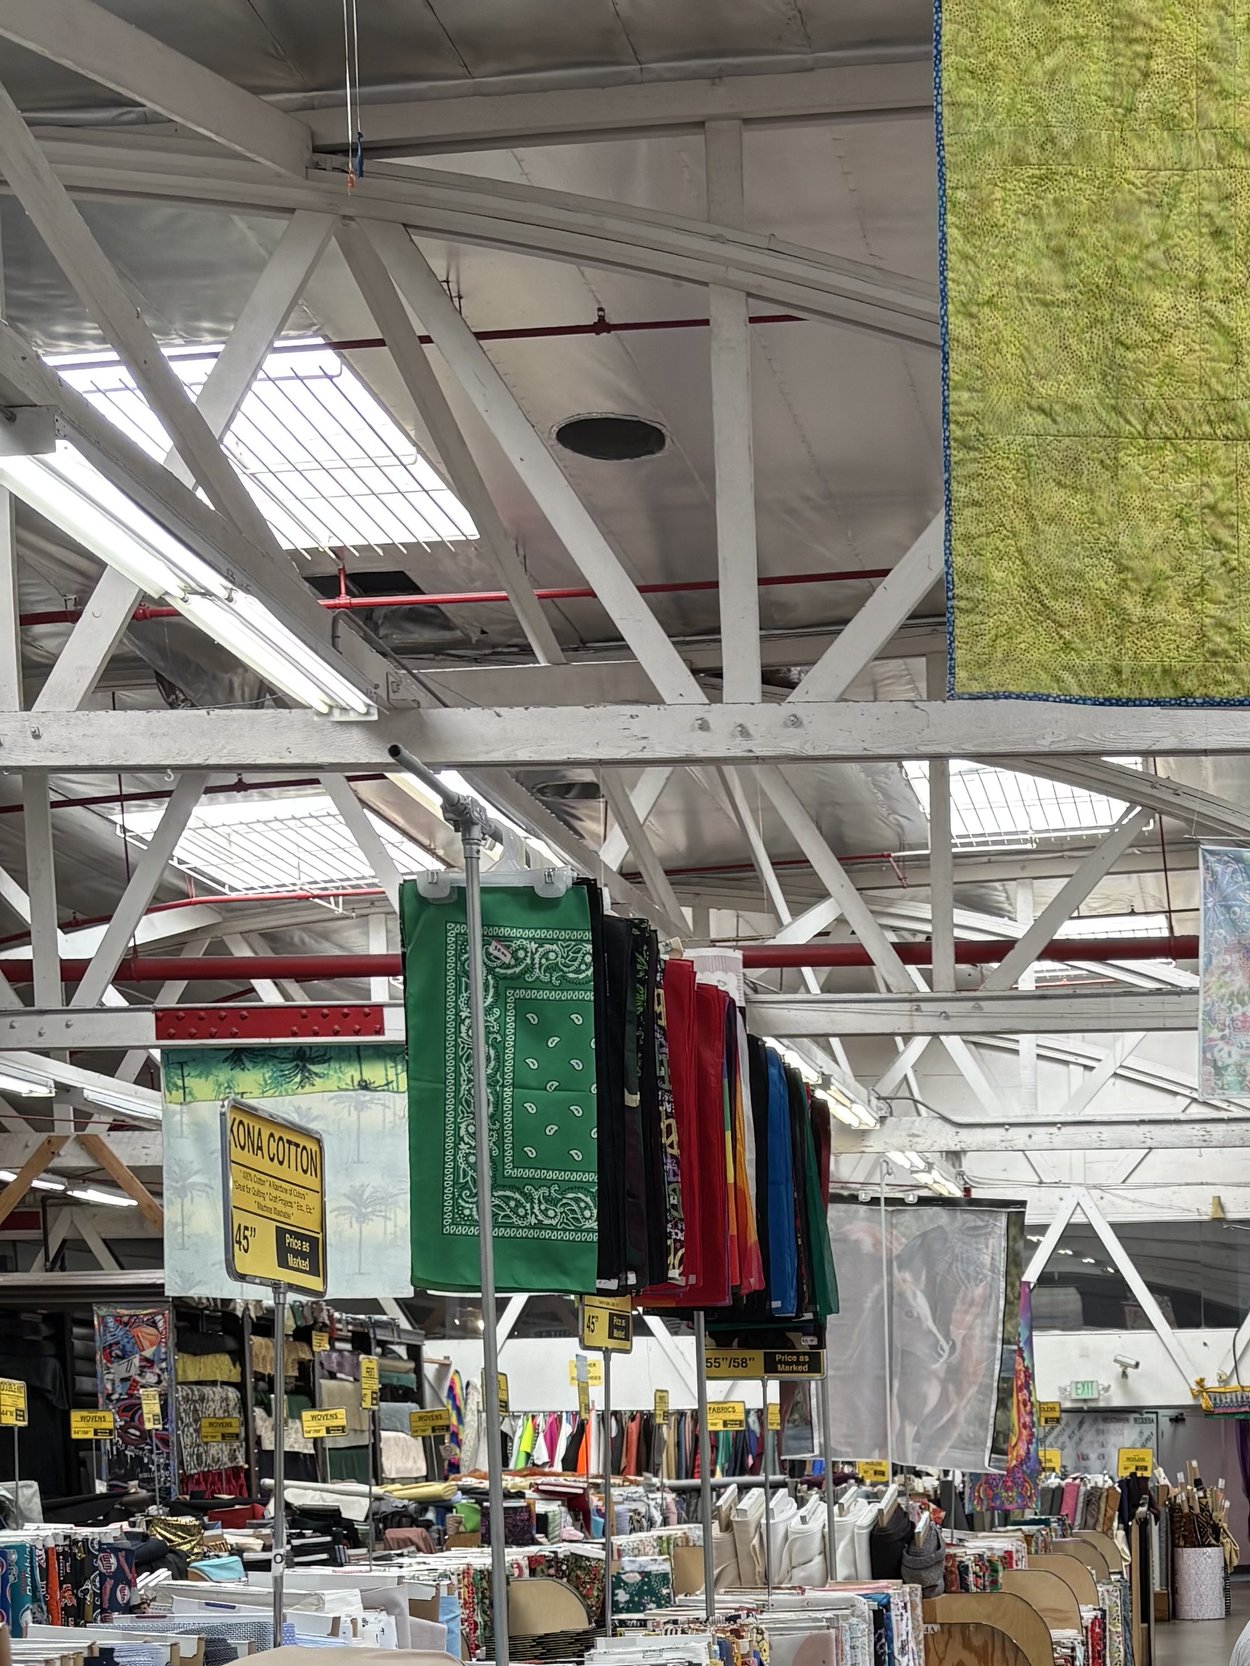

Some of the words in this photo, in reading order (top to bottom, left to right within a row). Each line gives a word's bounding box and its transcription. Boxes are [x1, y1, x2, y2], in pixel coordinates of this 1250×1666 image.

[268, 1132, 318, 1178] COTTON
[285, 1234, 301, 1250] Price
[302, 1241, 310, 1252] as
[287, 1254, 309, 1271] Marked
[1075, 1381, 1094, 1396] EXIT
[311, 1413, 338, 1421] WOVENS
